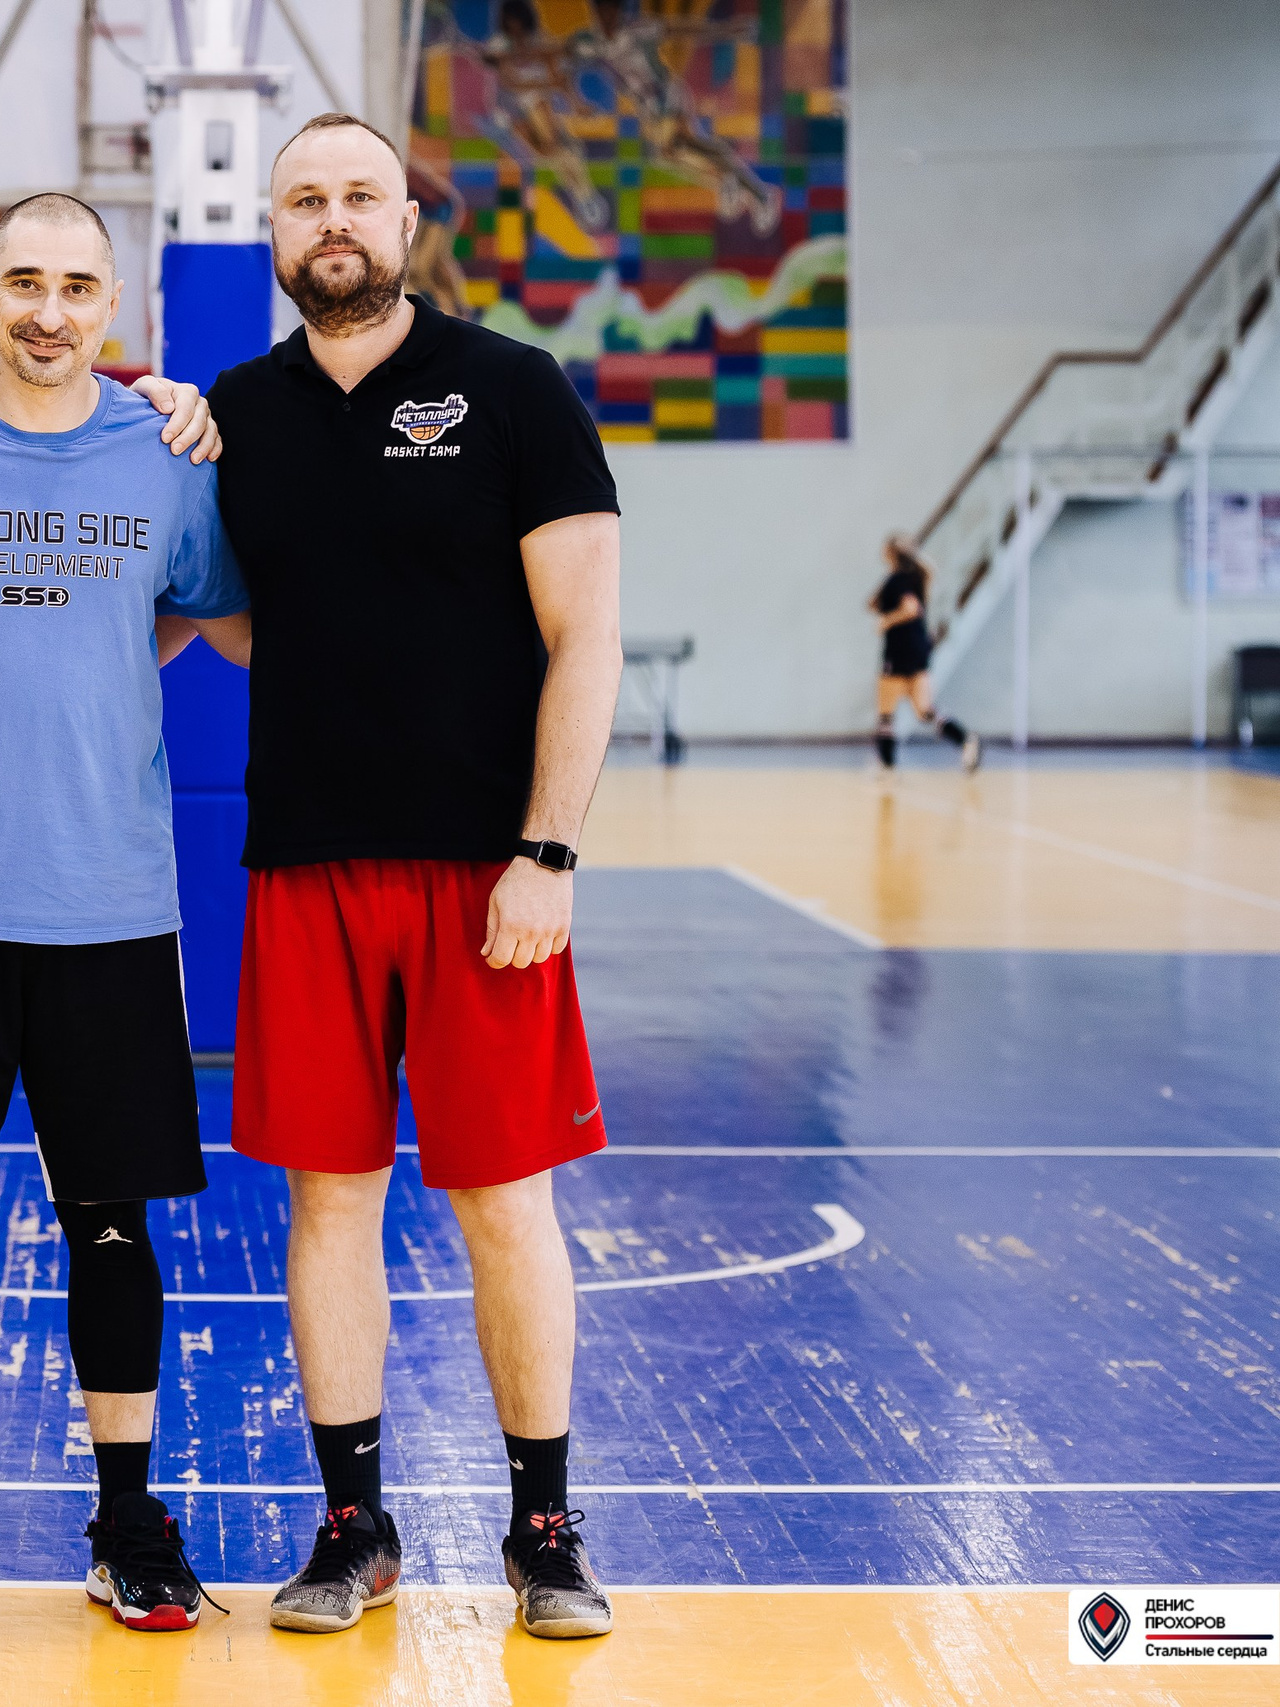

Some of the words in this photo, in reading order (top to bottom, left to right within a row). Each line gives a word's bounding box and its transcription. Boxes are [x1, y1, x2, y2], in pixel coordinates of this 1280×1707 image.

[384, 446, 427, 457] BASKET
[429, 445, 461, 457] CAMP
[77, 512, 151, 552] SIDE
